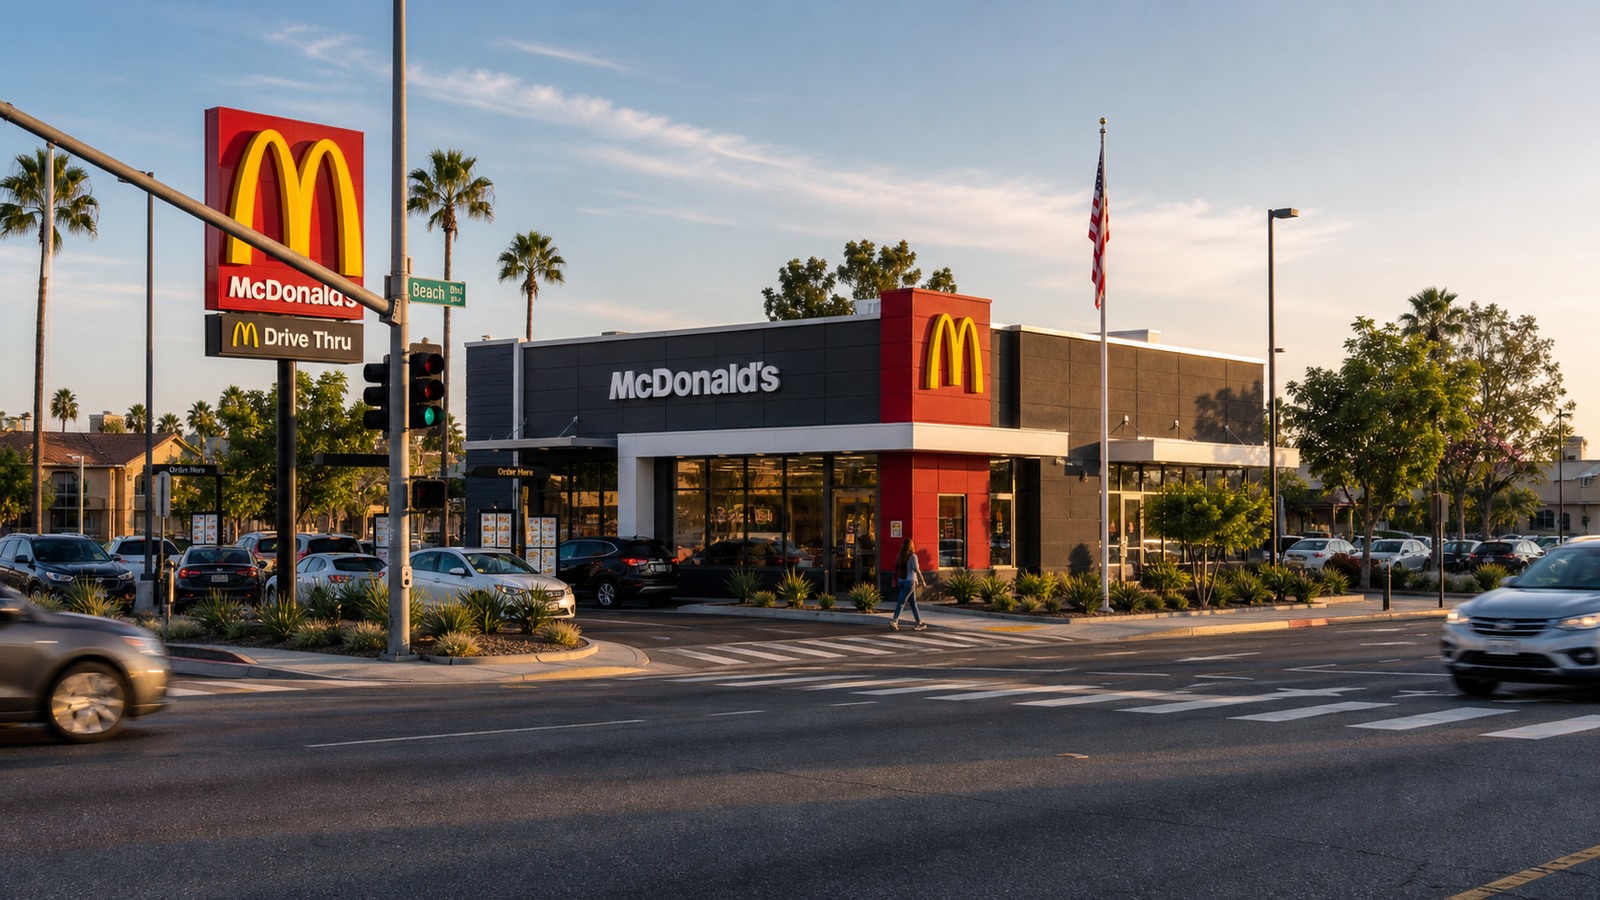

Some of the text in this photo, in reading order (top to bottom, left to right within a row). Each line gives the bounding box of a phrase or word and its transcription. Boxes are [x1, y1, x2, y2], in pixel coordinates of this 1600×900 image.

[412, 282, 445, 300] Beach
[264, 327, 309, 348] Drive
[313, 330, 351, 350] Thru
[609, 361, 781, 400] McDonald's
[497, 467, 534, 477] Order Here
